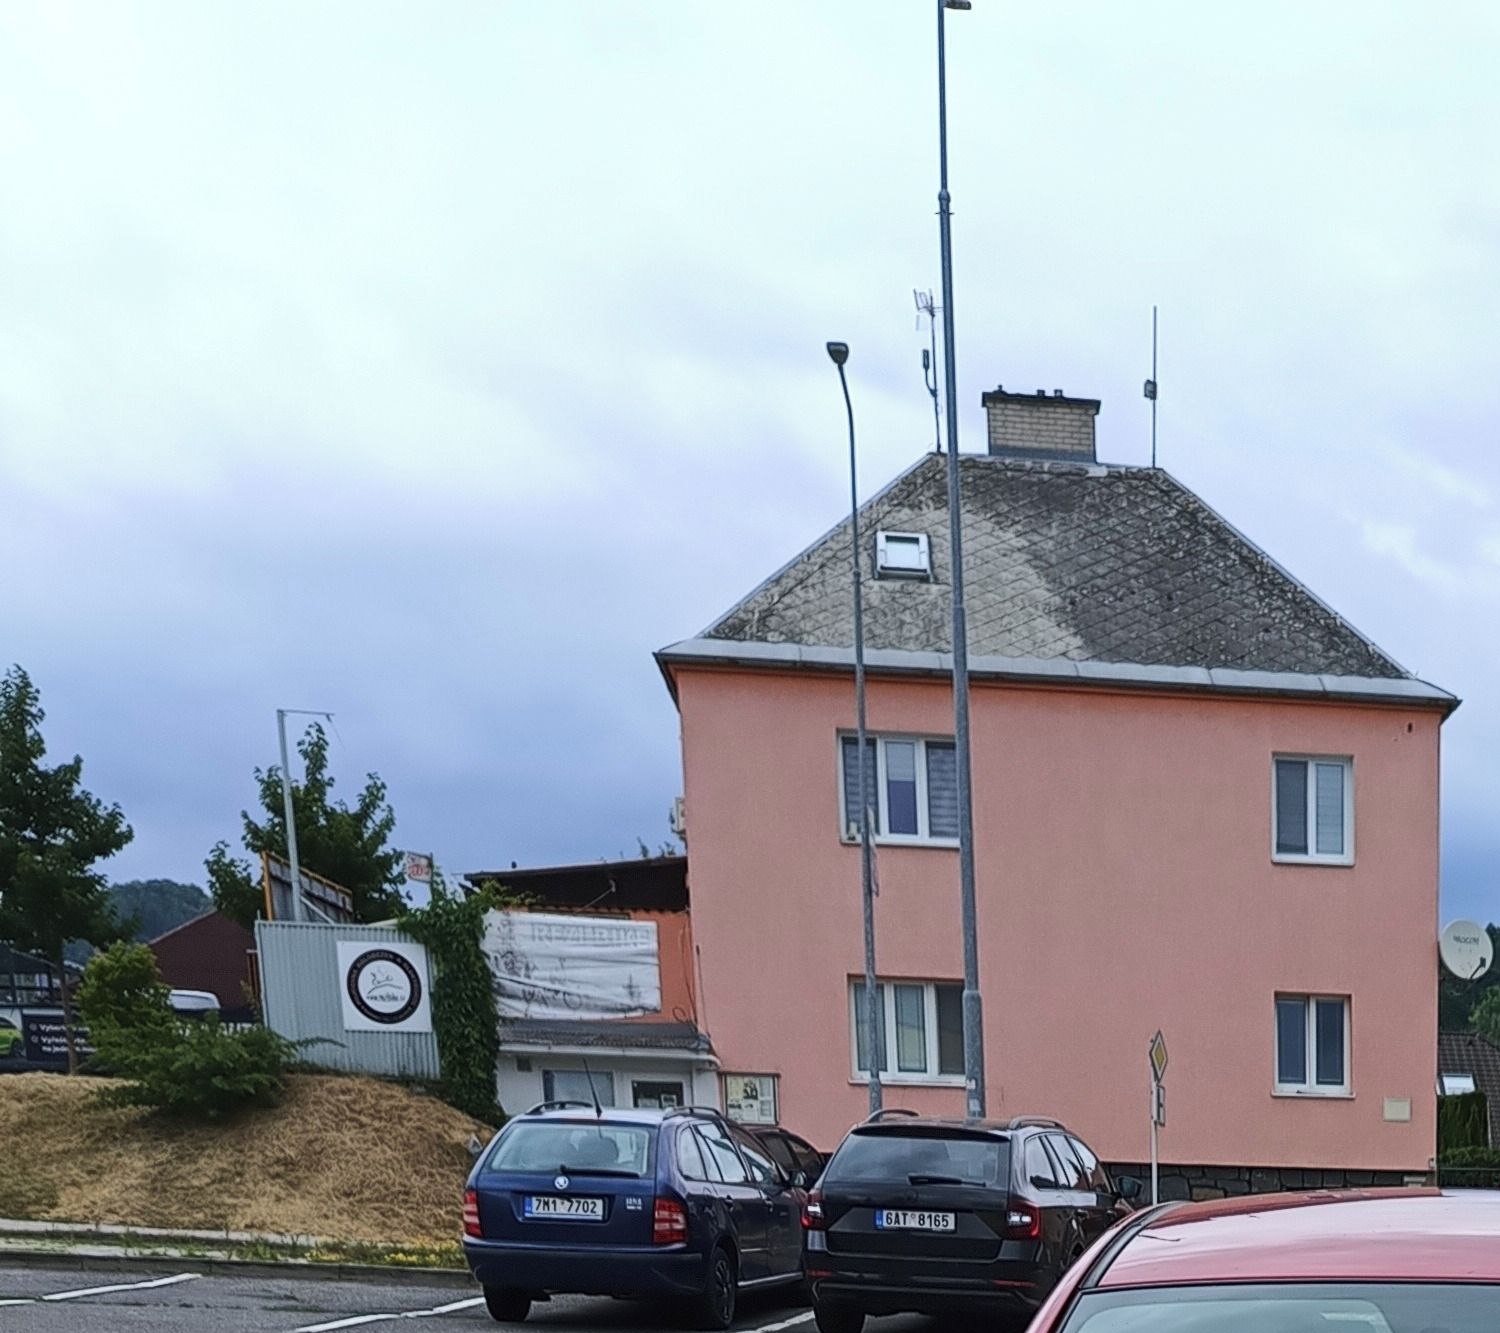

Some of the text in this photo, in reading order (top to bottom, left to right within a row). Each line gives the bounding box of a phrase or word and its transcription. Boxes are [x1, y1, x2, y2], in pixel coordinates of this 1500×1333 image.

[567, 1200, 597, 1214] 7702
[886, 1212, 949, 1228] 6AT 8165
